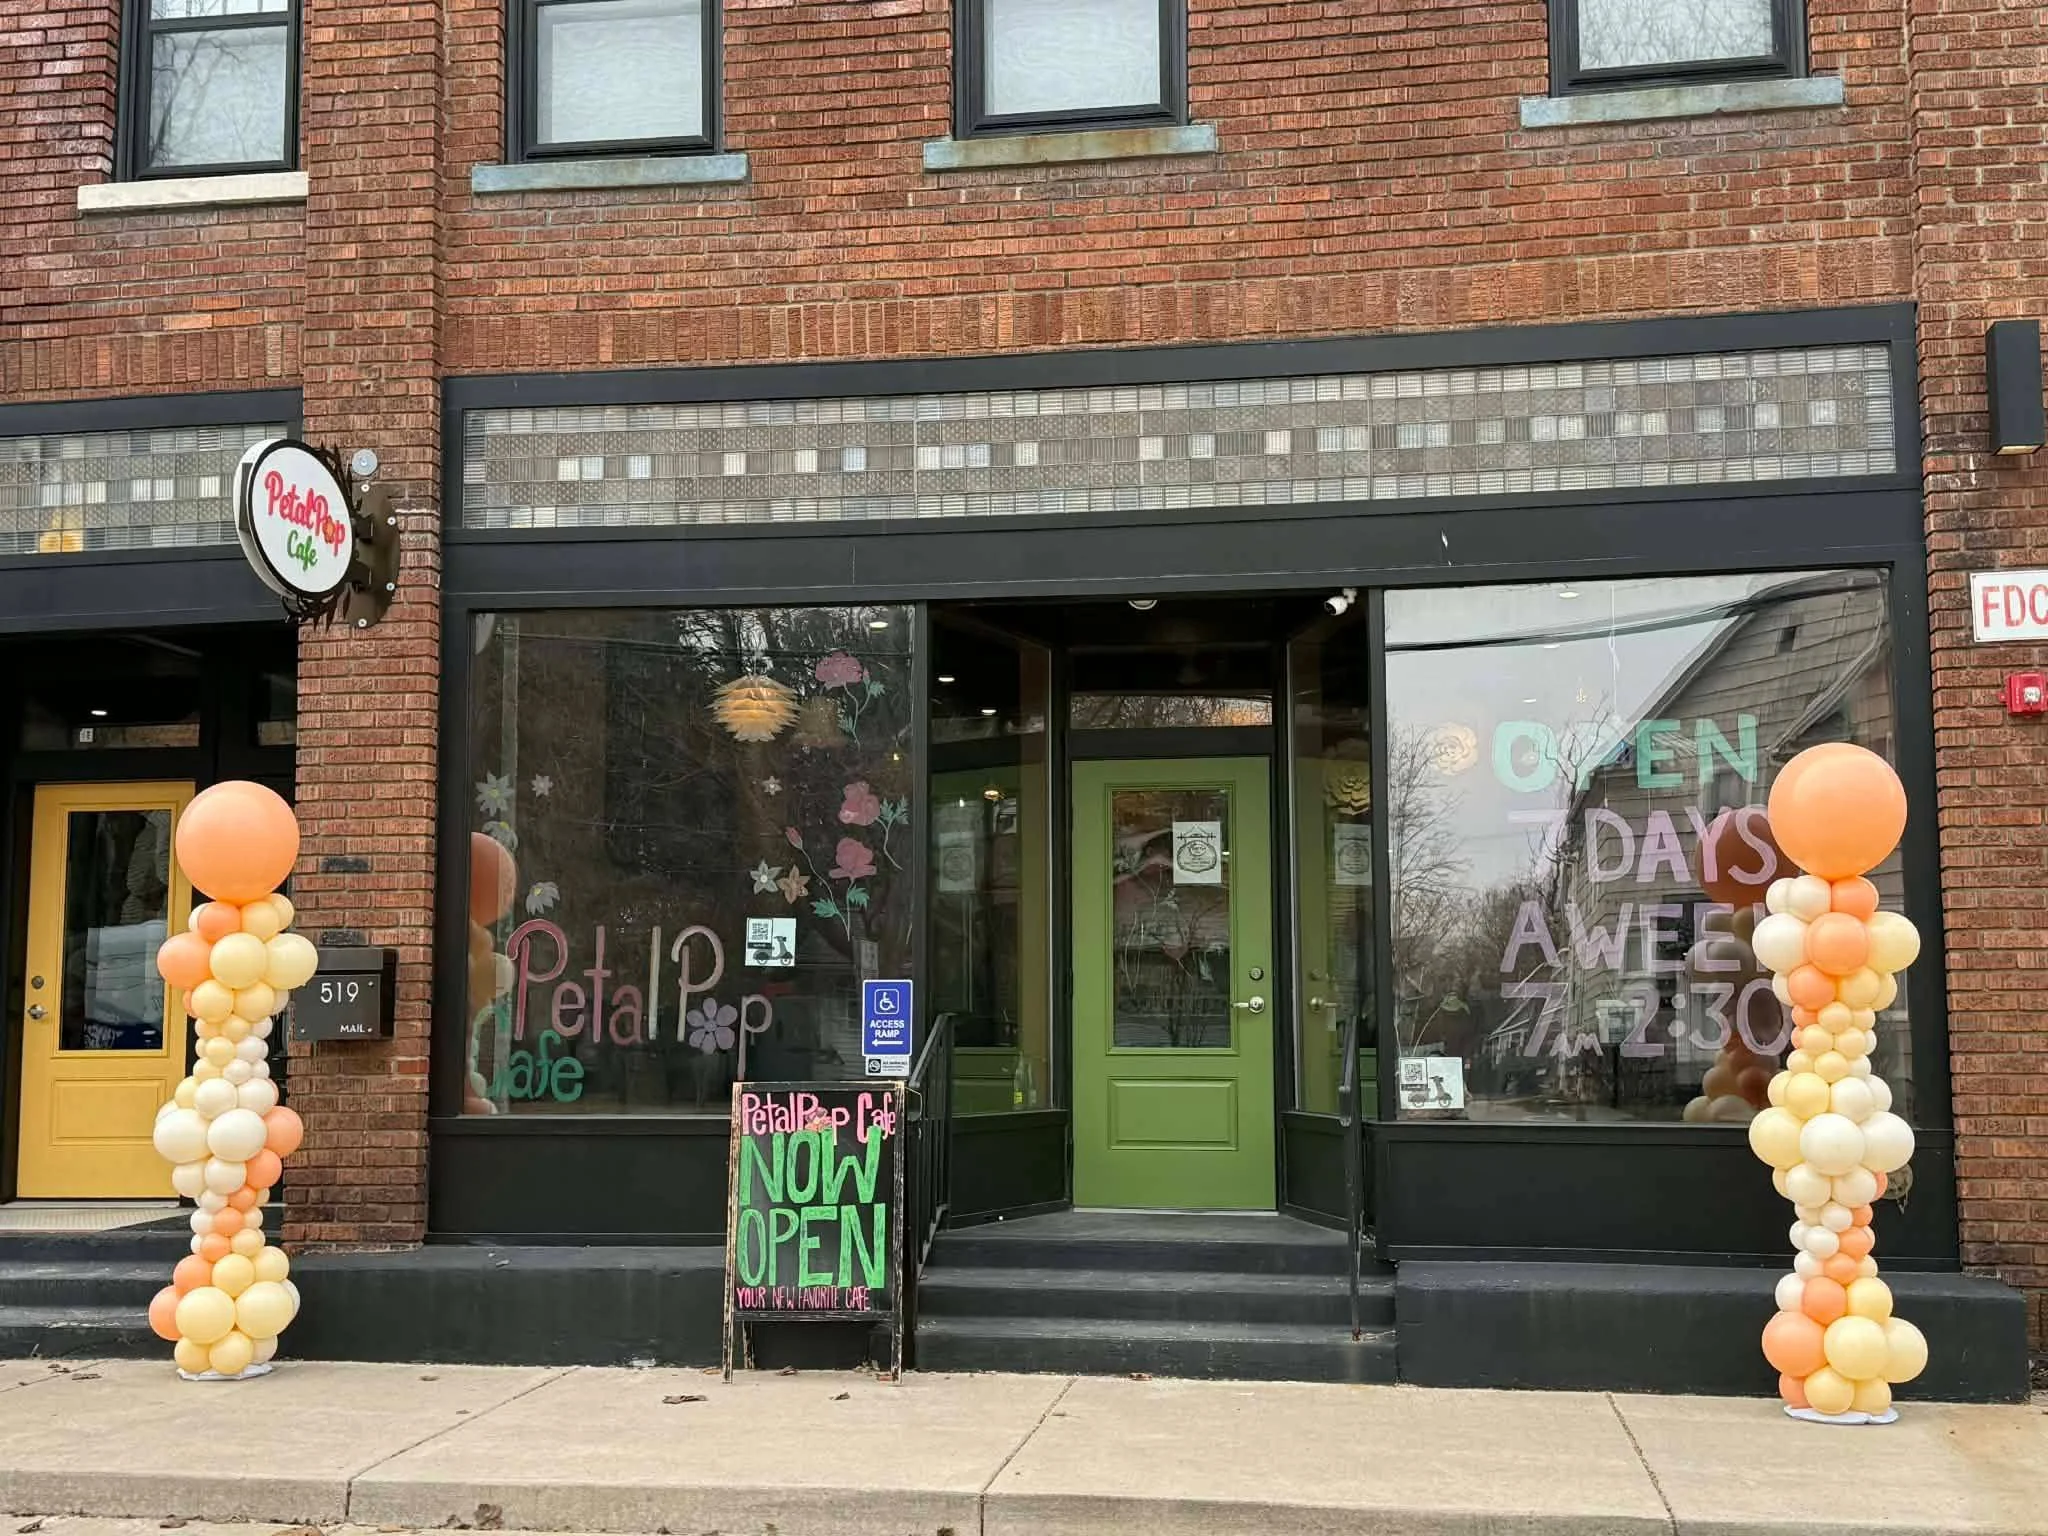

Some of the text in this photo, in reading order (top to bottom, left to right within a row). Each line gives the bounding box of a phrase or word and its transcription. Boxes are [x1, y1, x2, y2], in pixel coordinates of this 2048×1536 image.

[286, 529, 318, 572] Cafe
[1492, 713, 1759, 793] OPEN
[1584, 803, 1778, 886] DAYS
[1563, 901, 1770, 974] WEE
[320, 981, 359, 1003] 519
[340, 1024, 366, 1033] MAIL
[870, 1019, 905, 1029] ACCESS
[874, 1029, 901, 1038] RAMP
[857, 1092, 896, 1144] Cafe
[739, 1125, 882, 1205] NOW
[736, 1202, 886, 1289] OPEN
[736, 1286, 871, 1311] YOUR NEW FAVORITE CAFE
